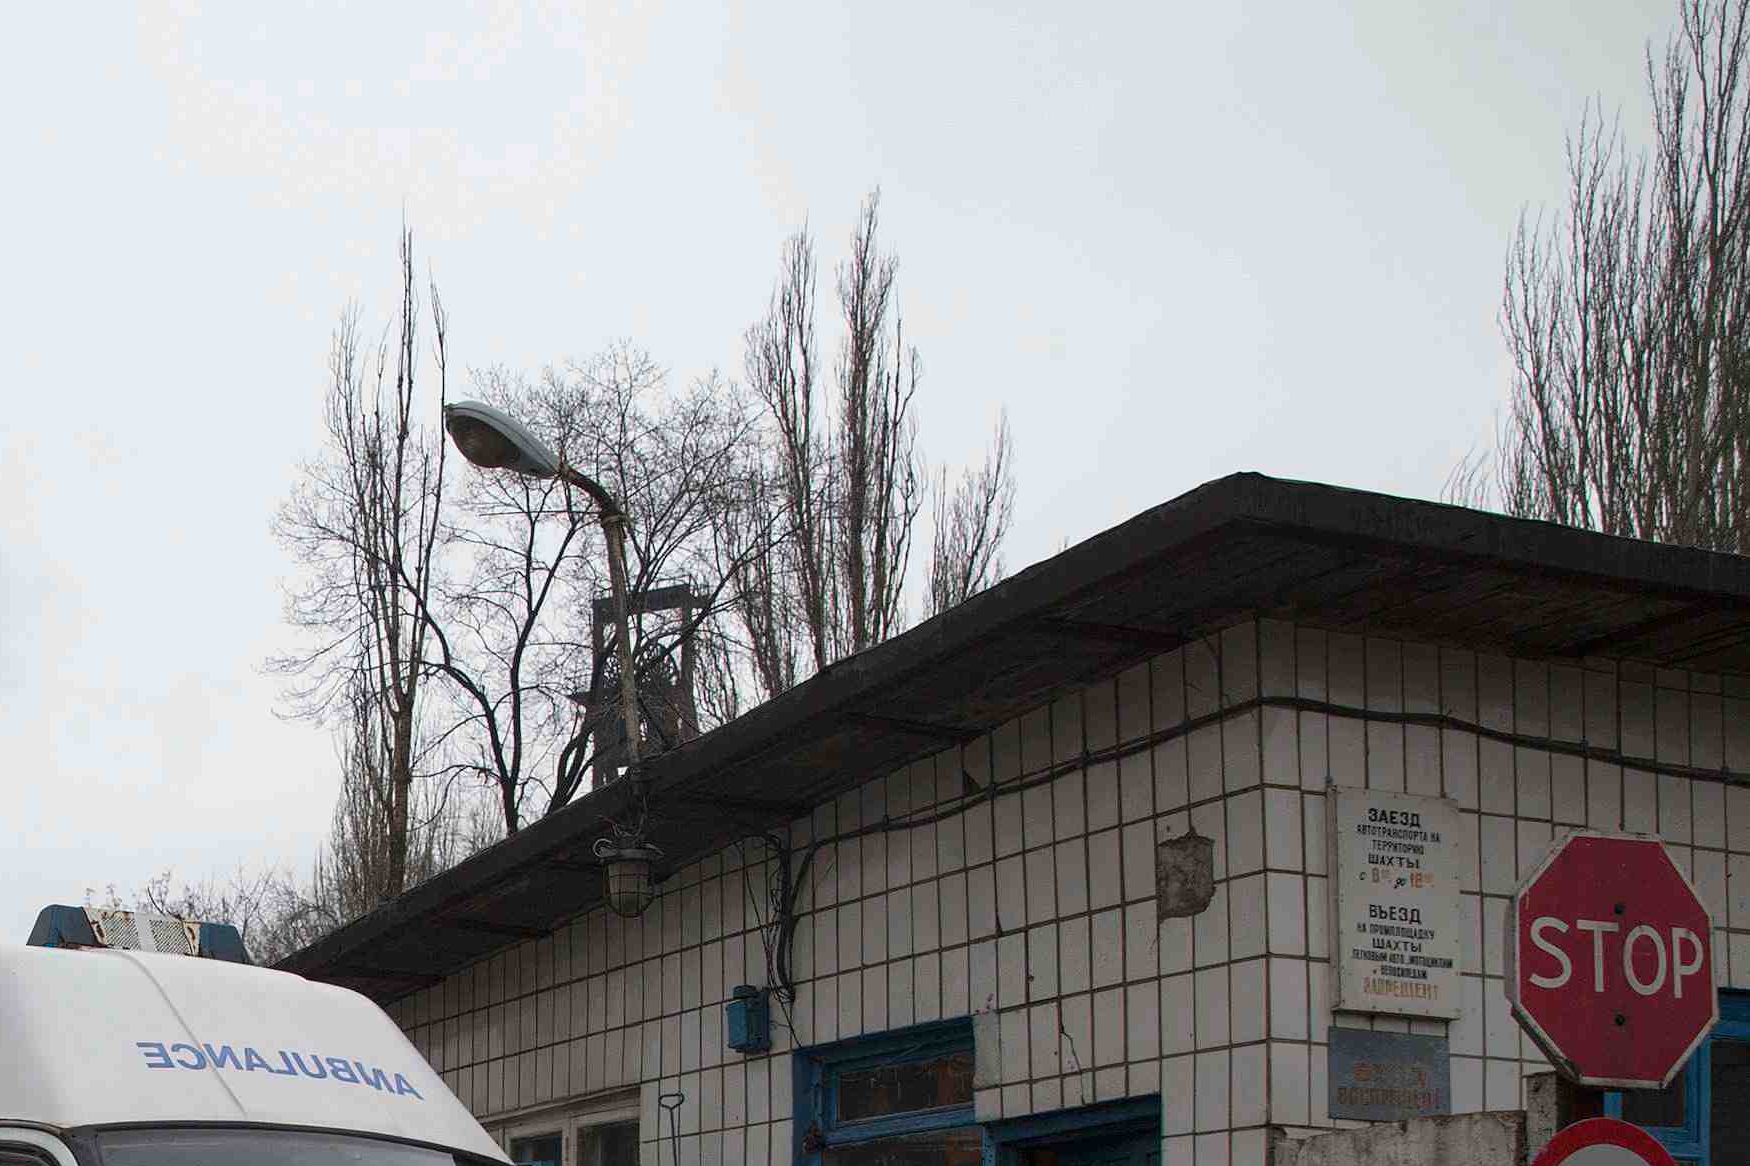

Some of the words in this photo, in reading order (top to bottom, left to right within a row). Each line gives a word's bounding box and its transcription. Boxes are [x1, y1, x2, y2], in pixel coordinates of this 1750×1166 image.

[1368, 808, 1420, 828] ЗАЕЗД
[1368, 853, 1419, 869] ШАХТЫ
[1372, 938, 1421, 953] ШАХТЫ
[1528, 916, 1704, 999] STOP
